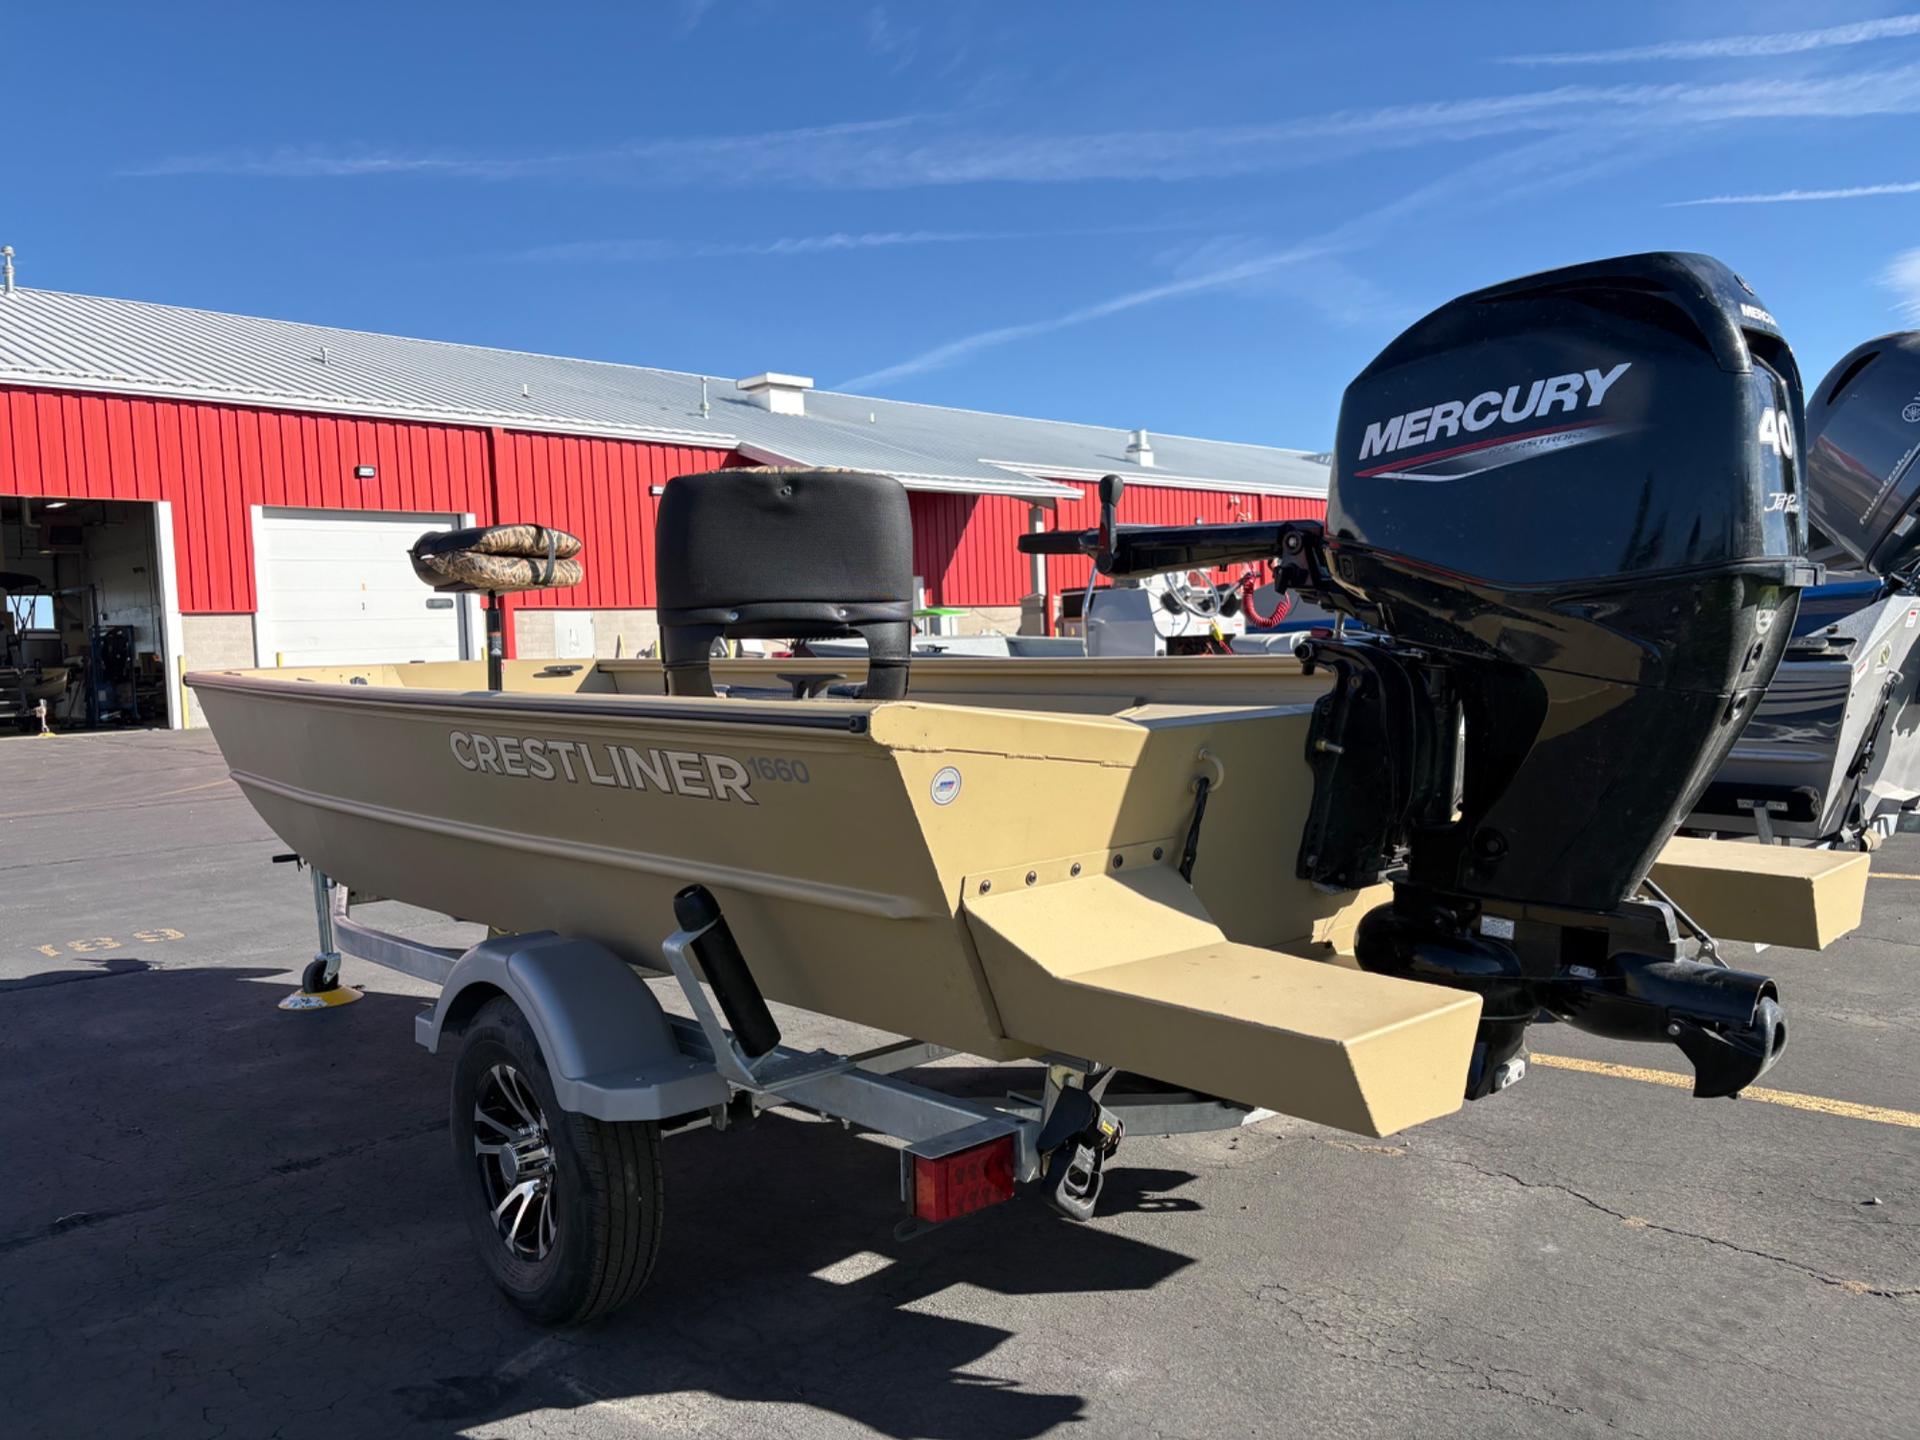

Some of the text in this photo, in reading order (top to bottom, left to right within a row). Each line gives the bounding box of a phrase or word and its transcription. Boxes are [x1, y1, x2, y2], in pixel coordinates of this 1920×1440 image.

[1358, 362, 1632, 461] MERCURY
[1759, 406, 1794, 460] 40
[449, 730, 811, 806] CRESTLINER 1660
